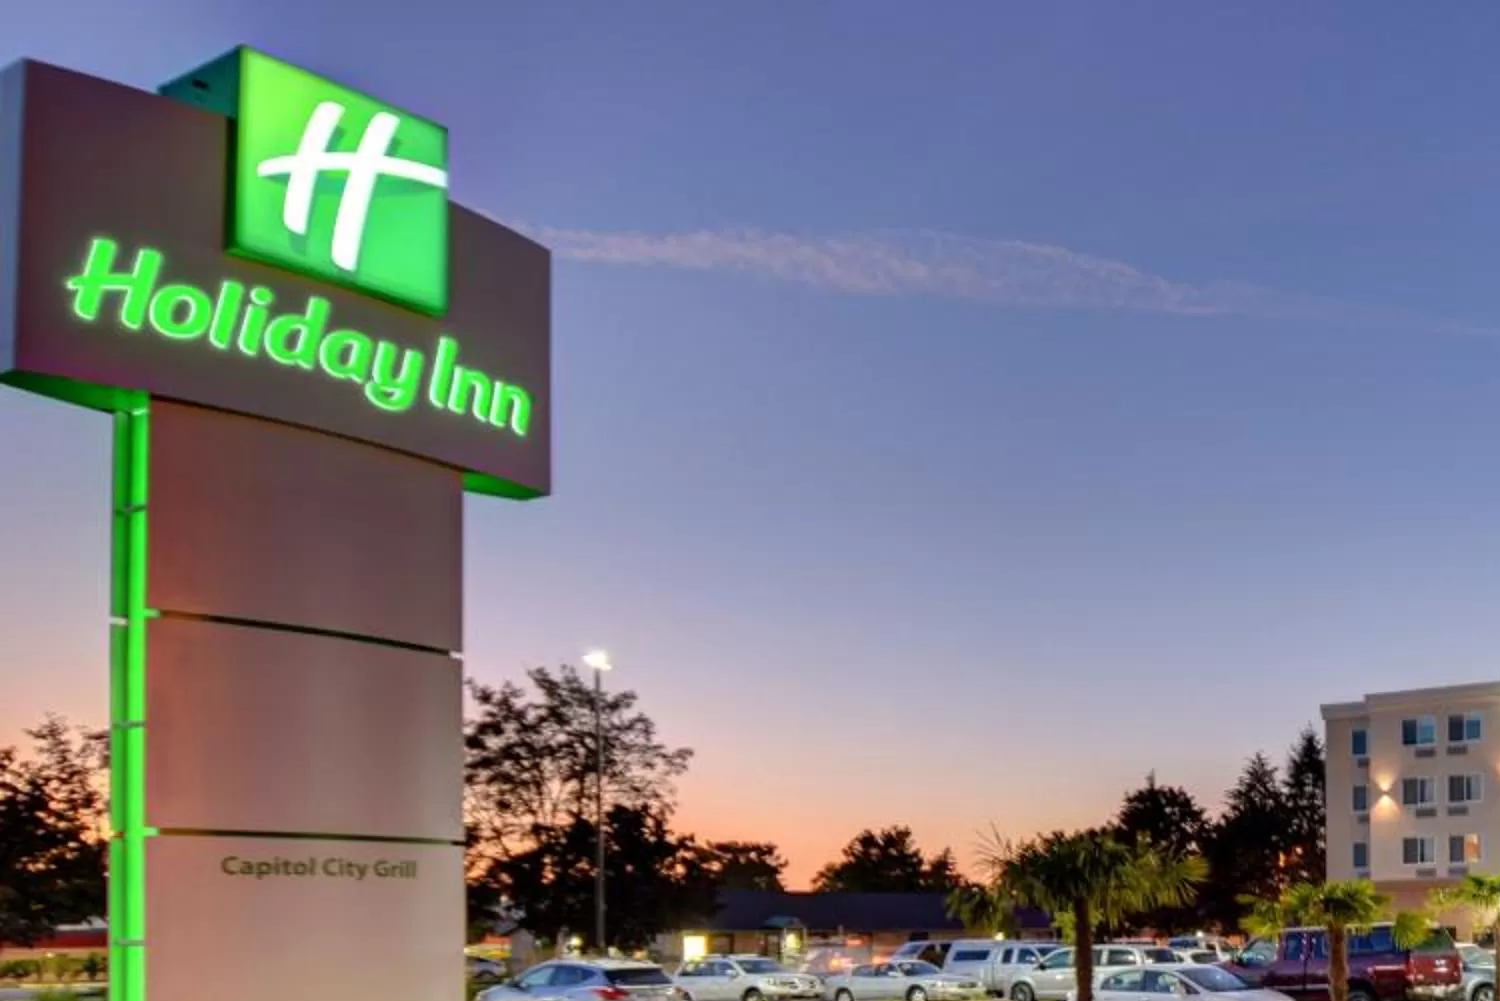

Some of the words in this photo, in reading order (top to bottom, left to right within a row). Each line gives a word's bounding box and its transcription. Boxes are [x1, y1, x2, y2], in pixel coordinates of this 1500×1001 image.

[257, 101, 447, 271] H
[65, 239, 424, 411] Holiday
[430, 336, 531, 435] Inn
[221, 856, 316, 879] Capitol
[322, 857, 368, 880] City
[373, 860, 417, 878] Grill
